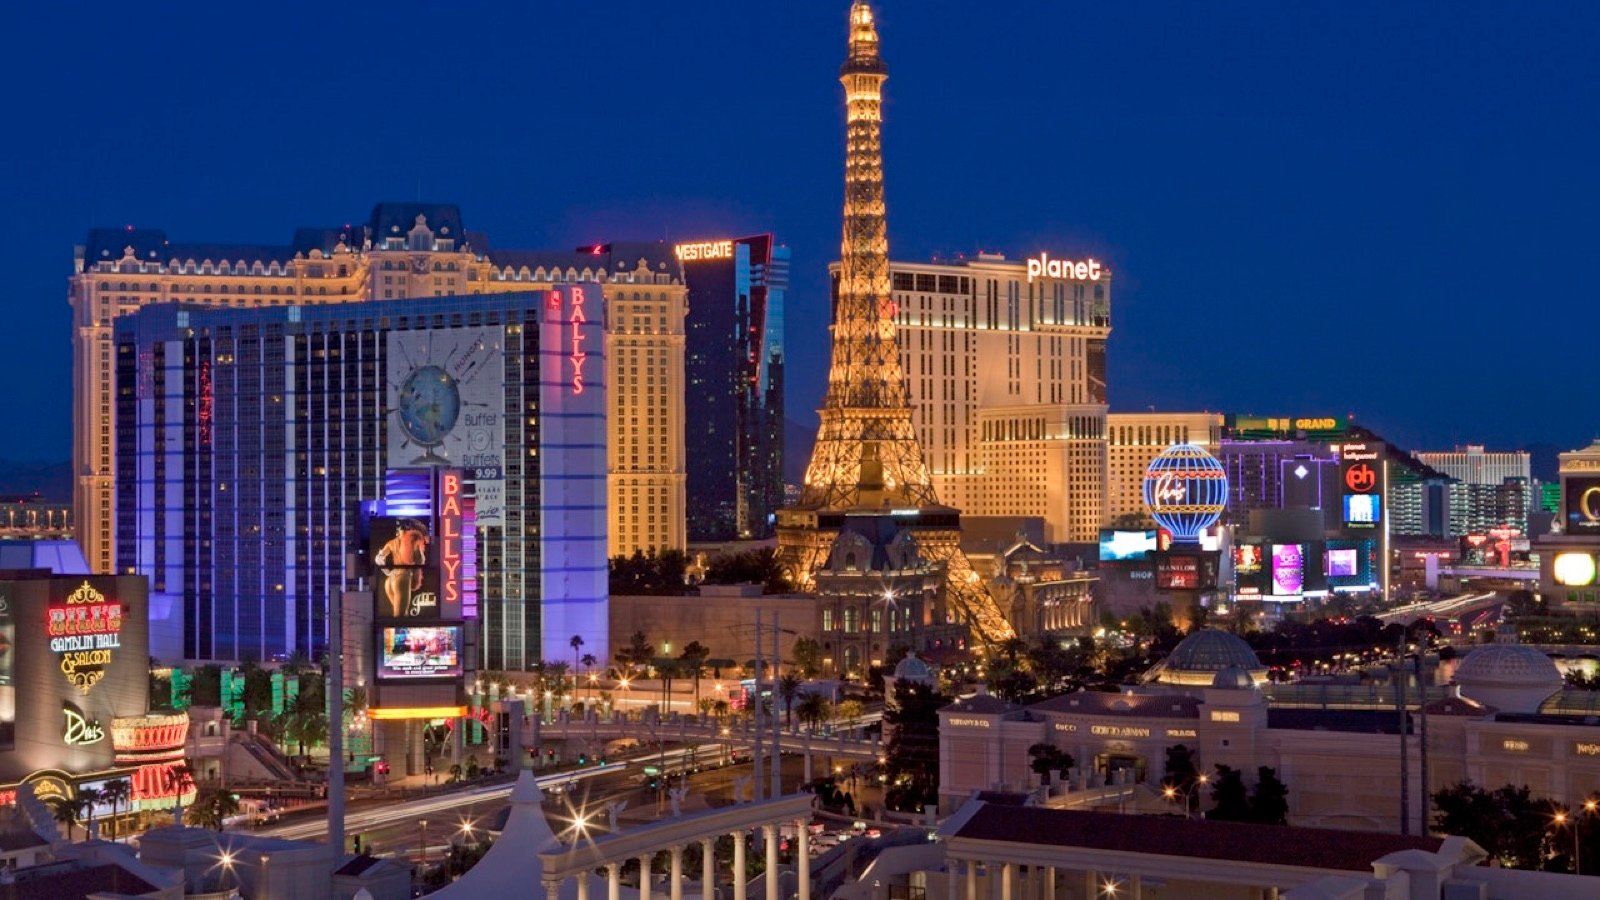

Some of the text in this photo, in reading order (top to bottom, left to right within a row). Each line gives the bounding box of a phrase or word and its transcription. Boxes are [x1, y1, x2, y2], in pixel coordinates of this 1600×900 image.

[1027, 252, 1101, 283] planet
[464, 413, 497, 426] Buffet
[1295, 418, 1336, 429] GRAND
[463, 454, 500, 466] Buffets
[1347, 464, 1375, 491] ph
[442, 475, 460, 601] BALLYS
[1130, 571, 1153, 579] SHOP
[49, 604, 120, 635] BILL'S
[97, 633, 120, 648] HALL
[61, 650, 111, 673] & SALOON
[949, 718, 974, 726] TIFFANY
[1055, 723, 1077, 731] GUCCI
[1091, 725, 1150, 736] GIORGIO ARMANI
